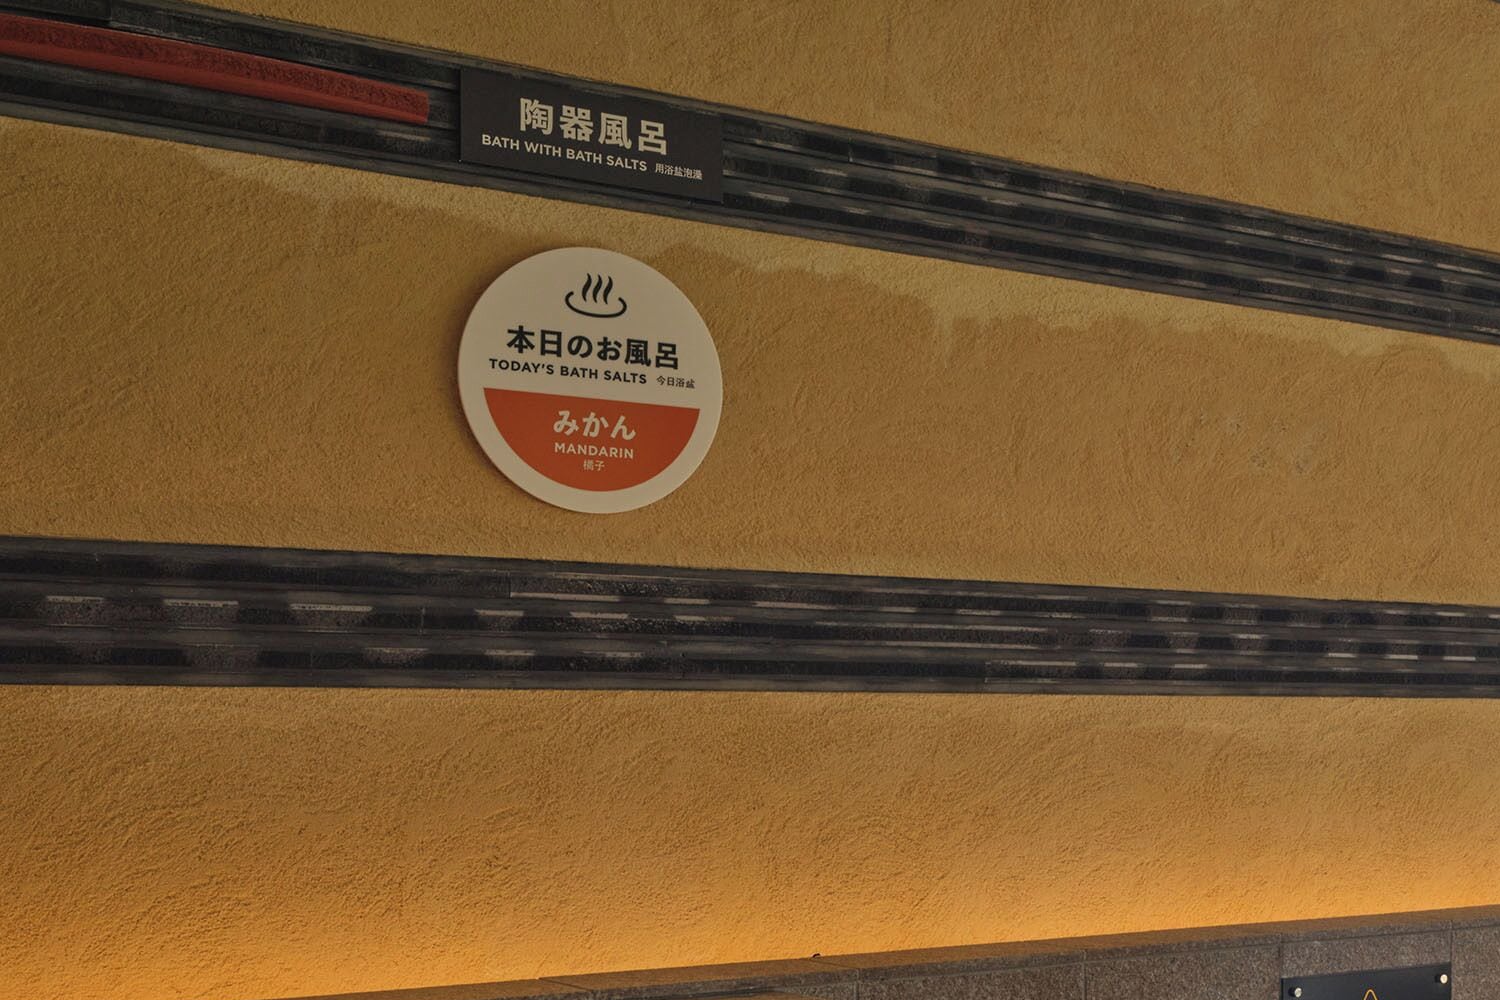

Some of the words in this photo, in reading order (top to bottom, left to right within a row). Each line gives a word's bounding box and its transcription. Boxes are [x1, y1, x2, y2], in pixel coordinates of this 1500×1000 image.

[519, 97, 668, 156] 陶器風呂
[482, 134, 520, 150] BATH
[524, 141, 562, 157] WITH
[566, 149, 602, 165] BATH
[606, 155, 648, 172] SALTS
[506, 325, 679, 370] 本日のお風呂
[489, 358, 555, 375] TODAY'S
[560, 366, 598, 380] BATH
[603, 370, 647, 384] SALTS
[553, 410, 636, 440] みかん
[554, 442, 634, 460] MANDARIN
